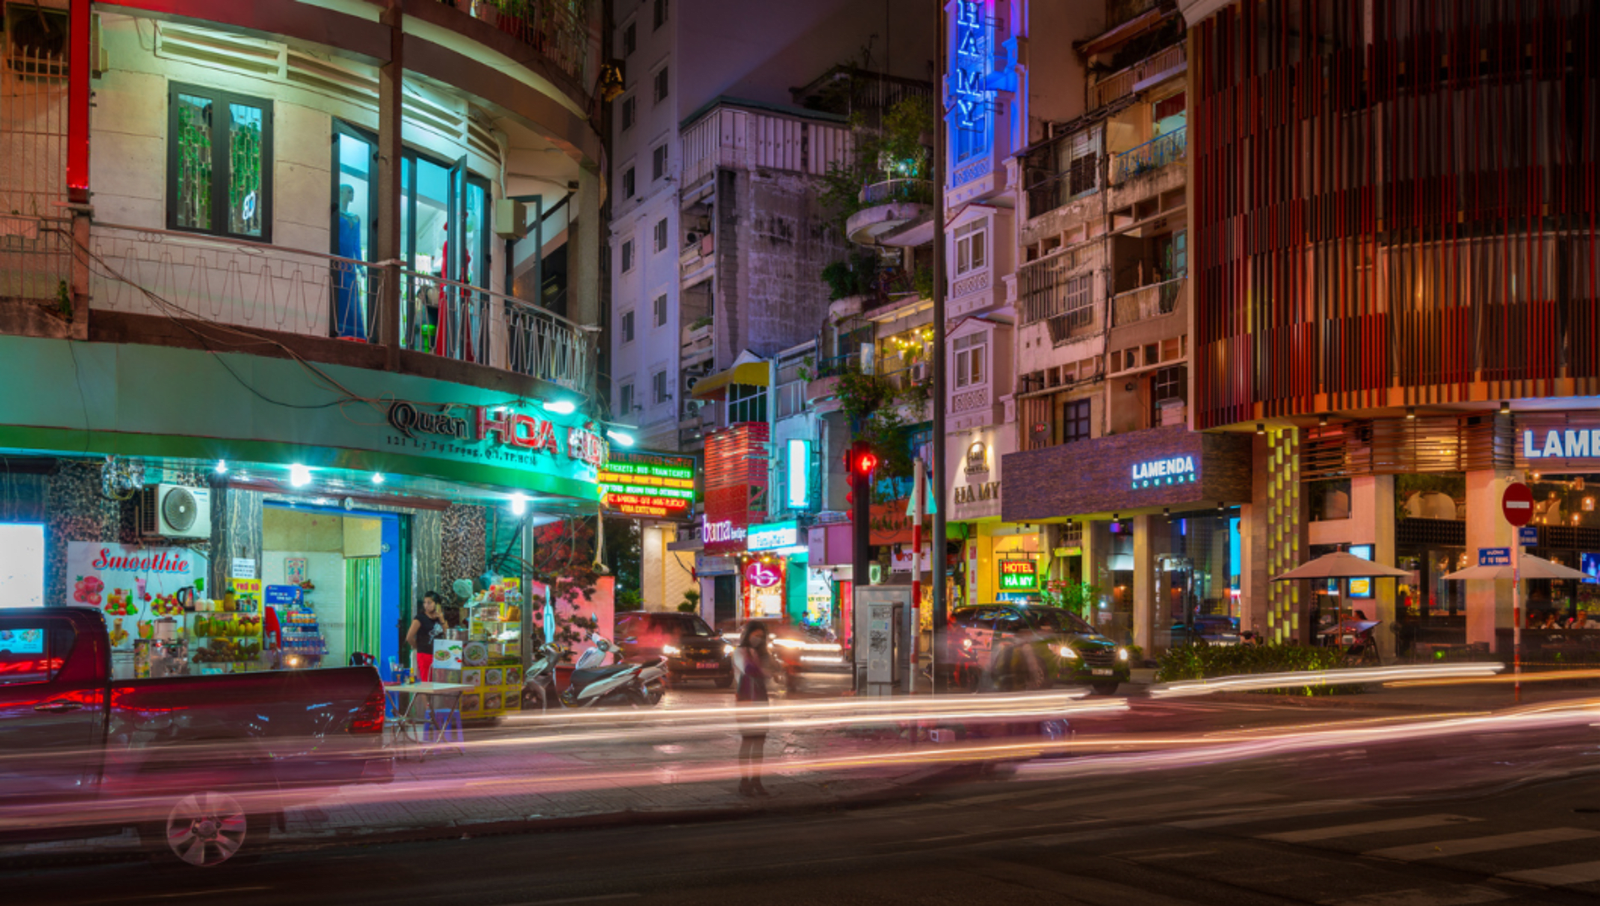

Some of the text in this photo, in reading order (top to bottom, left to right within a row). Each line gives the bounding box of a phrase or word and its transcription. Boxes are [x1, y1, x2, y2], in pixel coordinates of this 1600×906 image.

[388, 401, 470, 441] Quán
[476, 406, 562, 456] HOA
[387, 436, 406, 447] 121
[629, 453, 663, 466] SERVICES
[1132, 456, 1194, 480] LAMENDA
[1132, 473, 1195, 489] LOUNGE
[92, 547, 190, 574] Smoothie
[1004, 563, 1035, 573] HOTEL
[1020, 577, 1034, 586] MY
